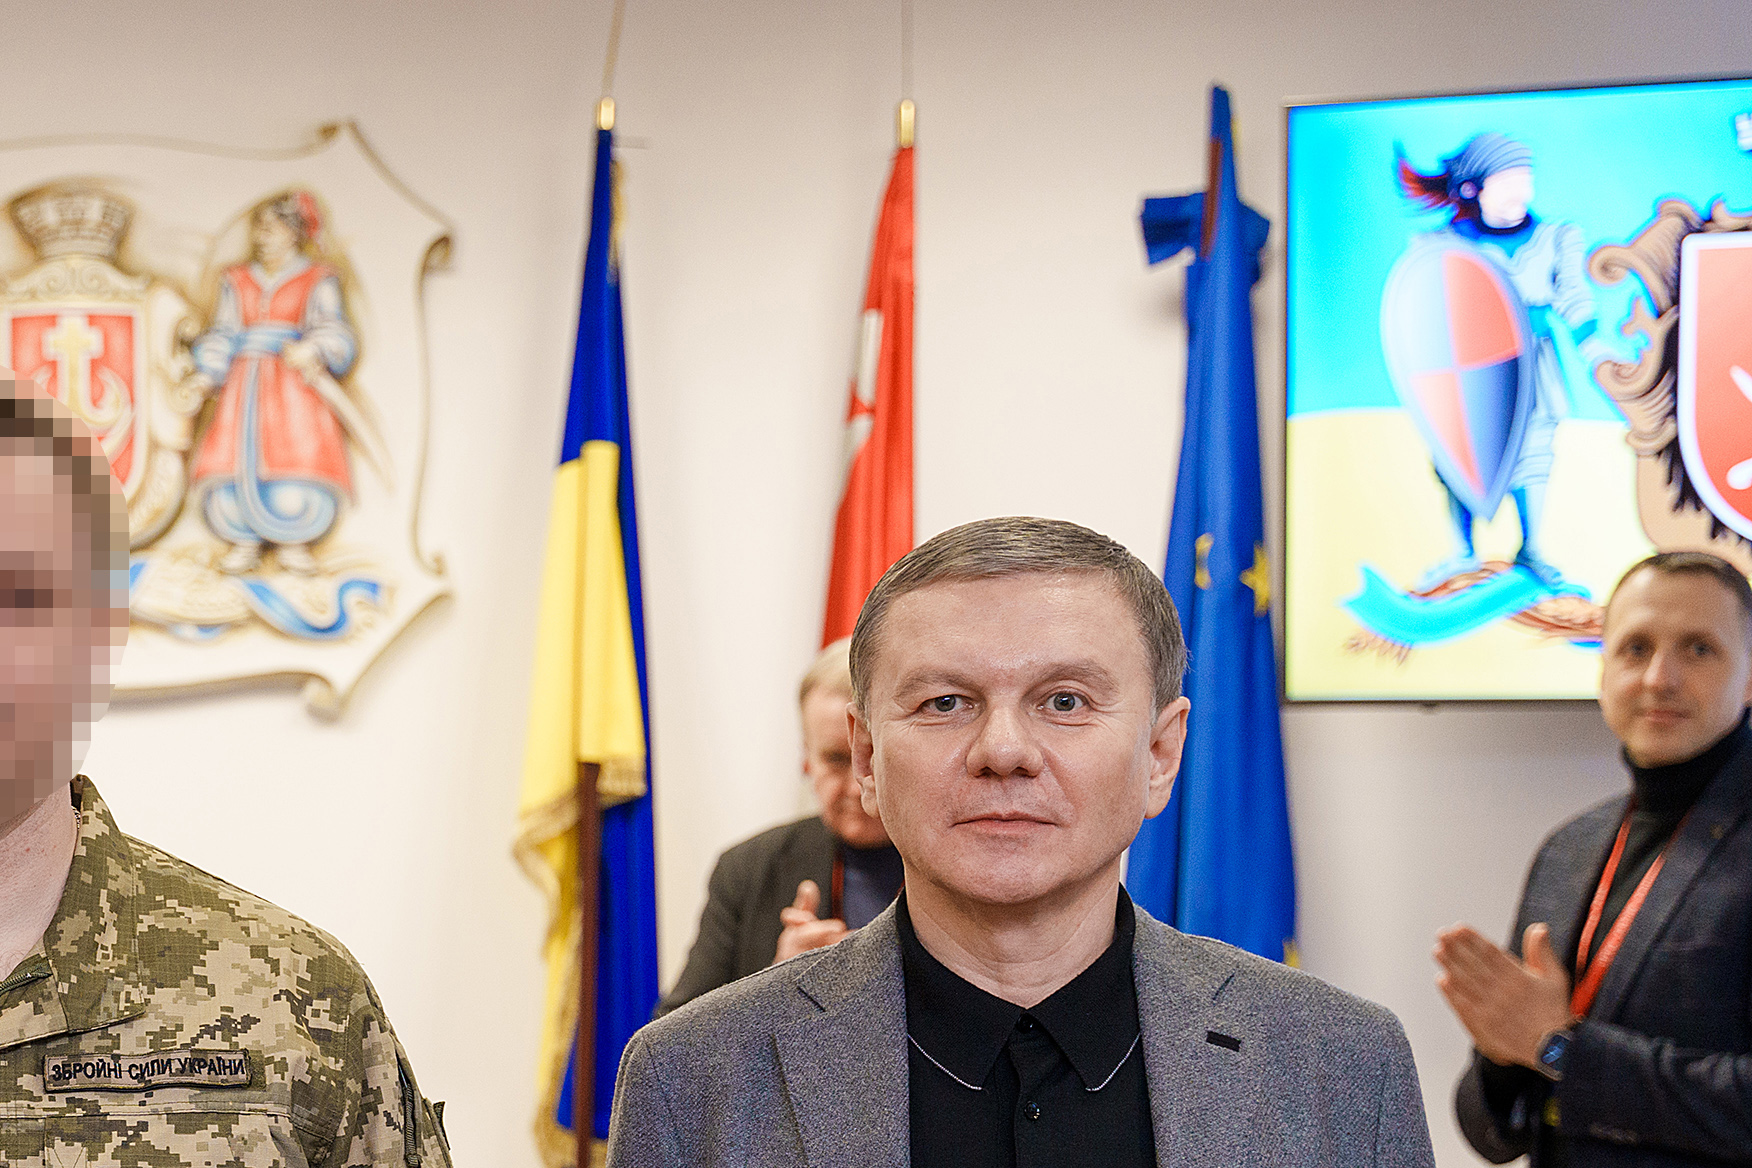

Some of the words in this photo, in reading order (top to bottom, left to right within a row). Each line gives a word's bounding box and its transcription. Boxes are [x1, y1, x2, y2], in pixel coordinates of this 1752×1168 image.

[51, 1058, 123, 1082] ЗБРОЙНІ
[128, 1058, 173, 1080] СИЛИ
[179, 1055, 246, 1076] УКРАЇНИ
